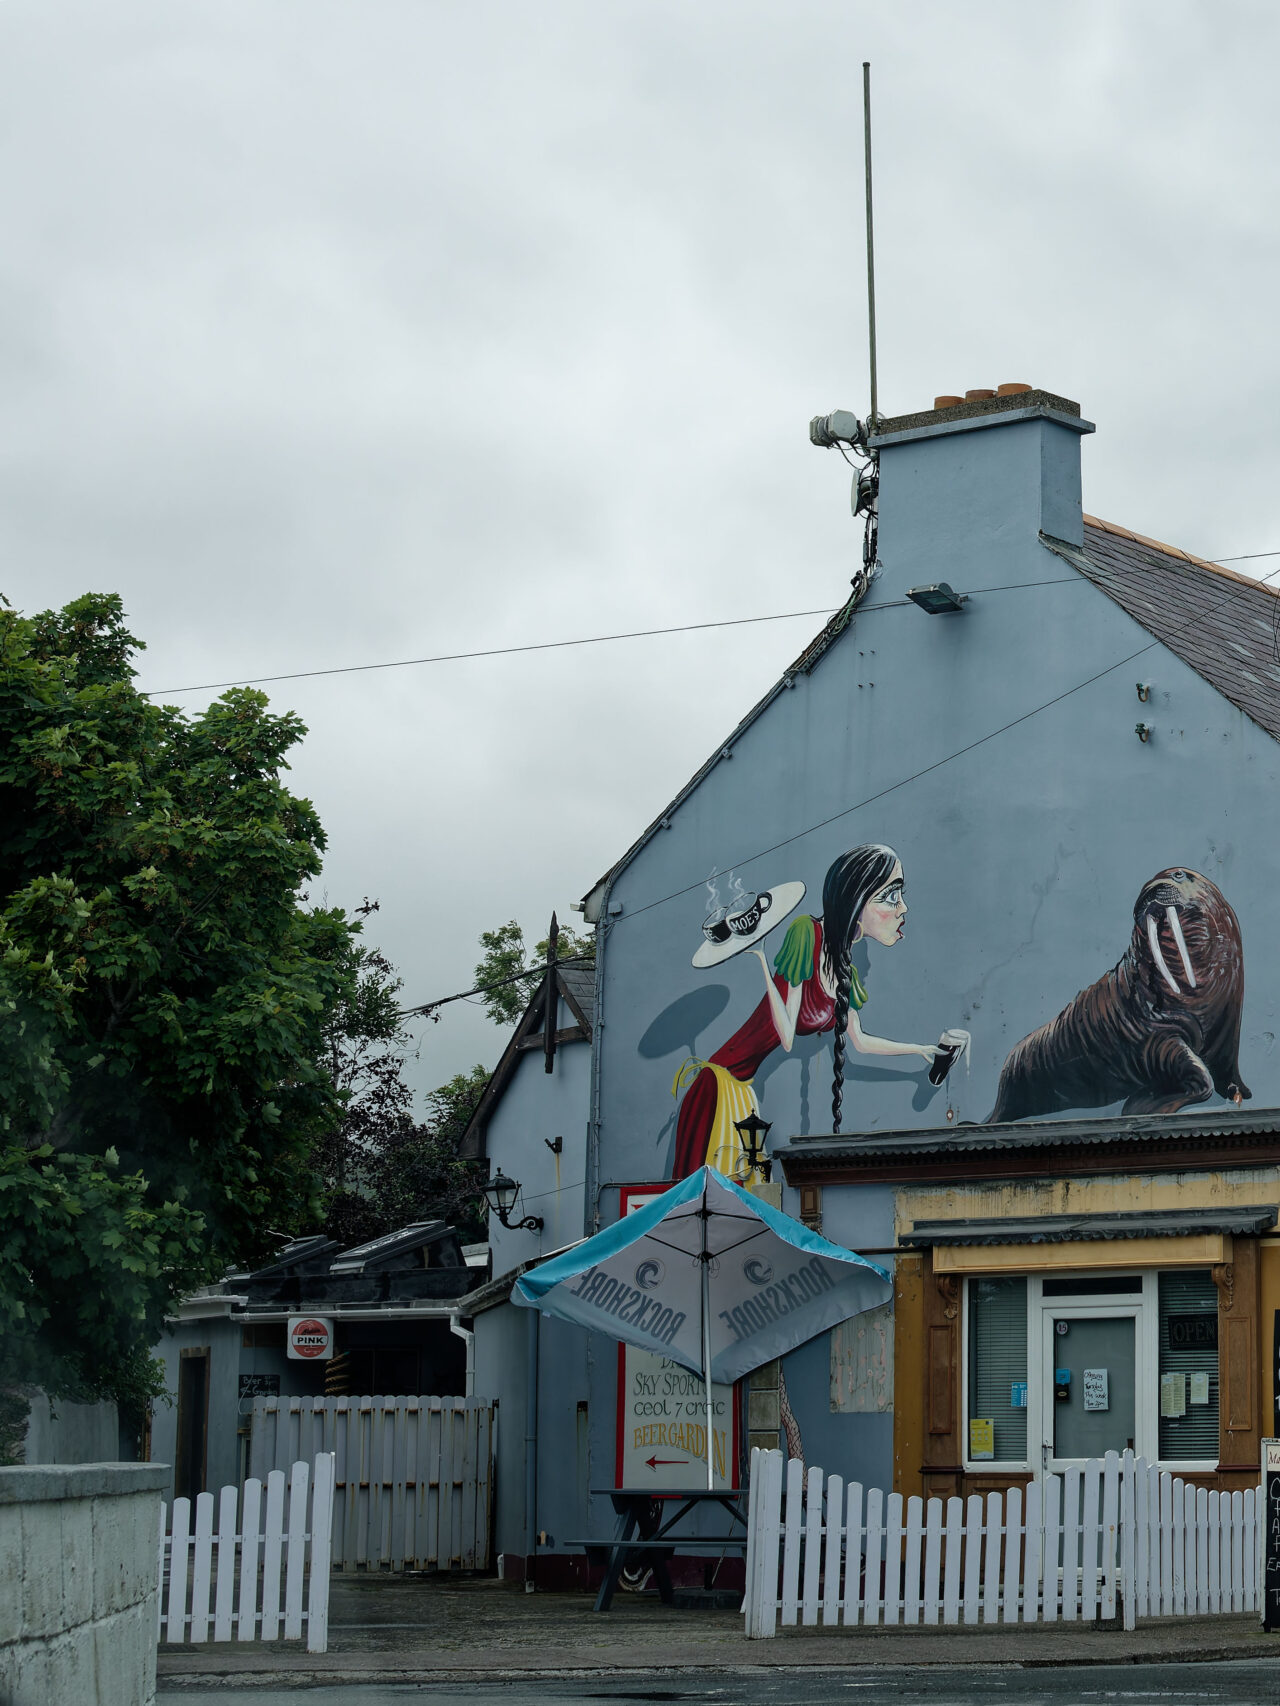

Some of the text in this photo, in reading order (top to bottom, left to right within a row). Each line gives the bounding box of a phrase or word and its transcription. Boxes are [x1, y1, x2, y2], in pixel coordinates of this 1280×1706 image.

[633, 1372, 661, 1396] SKY
[633, 1400, 671, 1416] ceol
[633, 1422, 667, 1450] BEER
